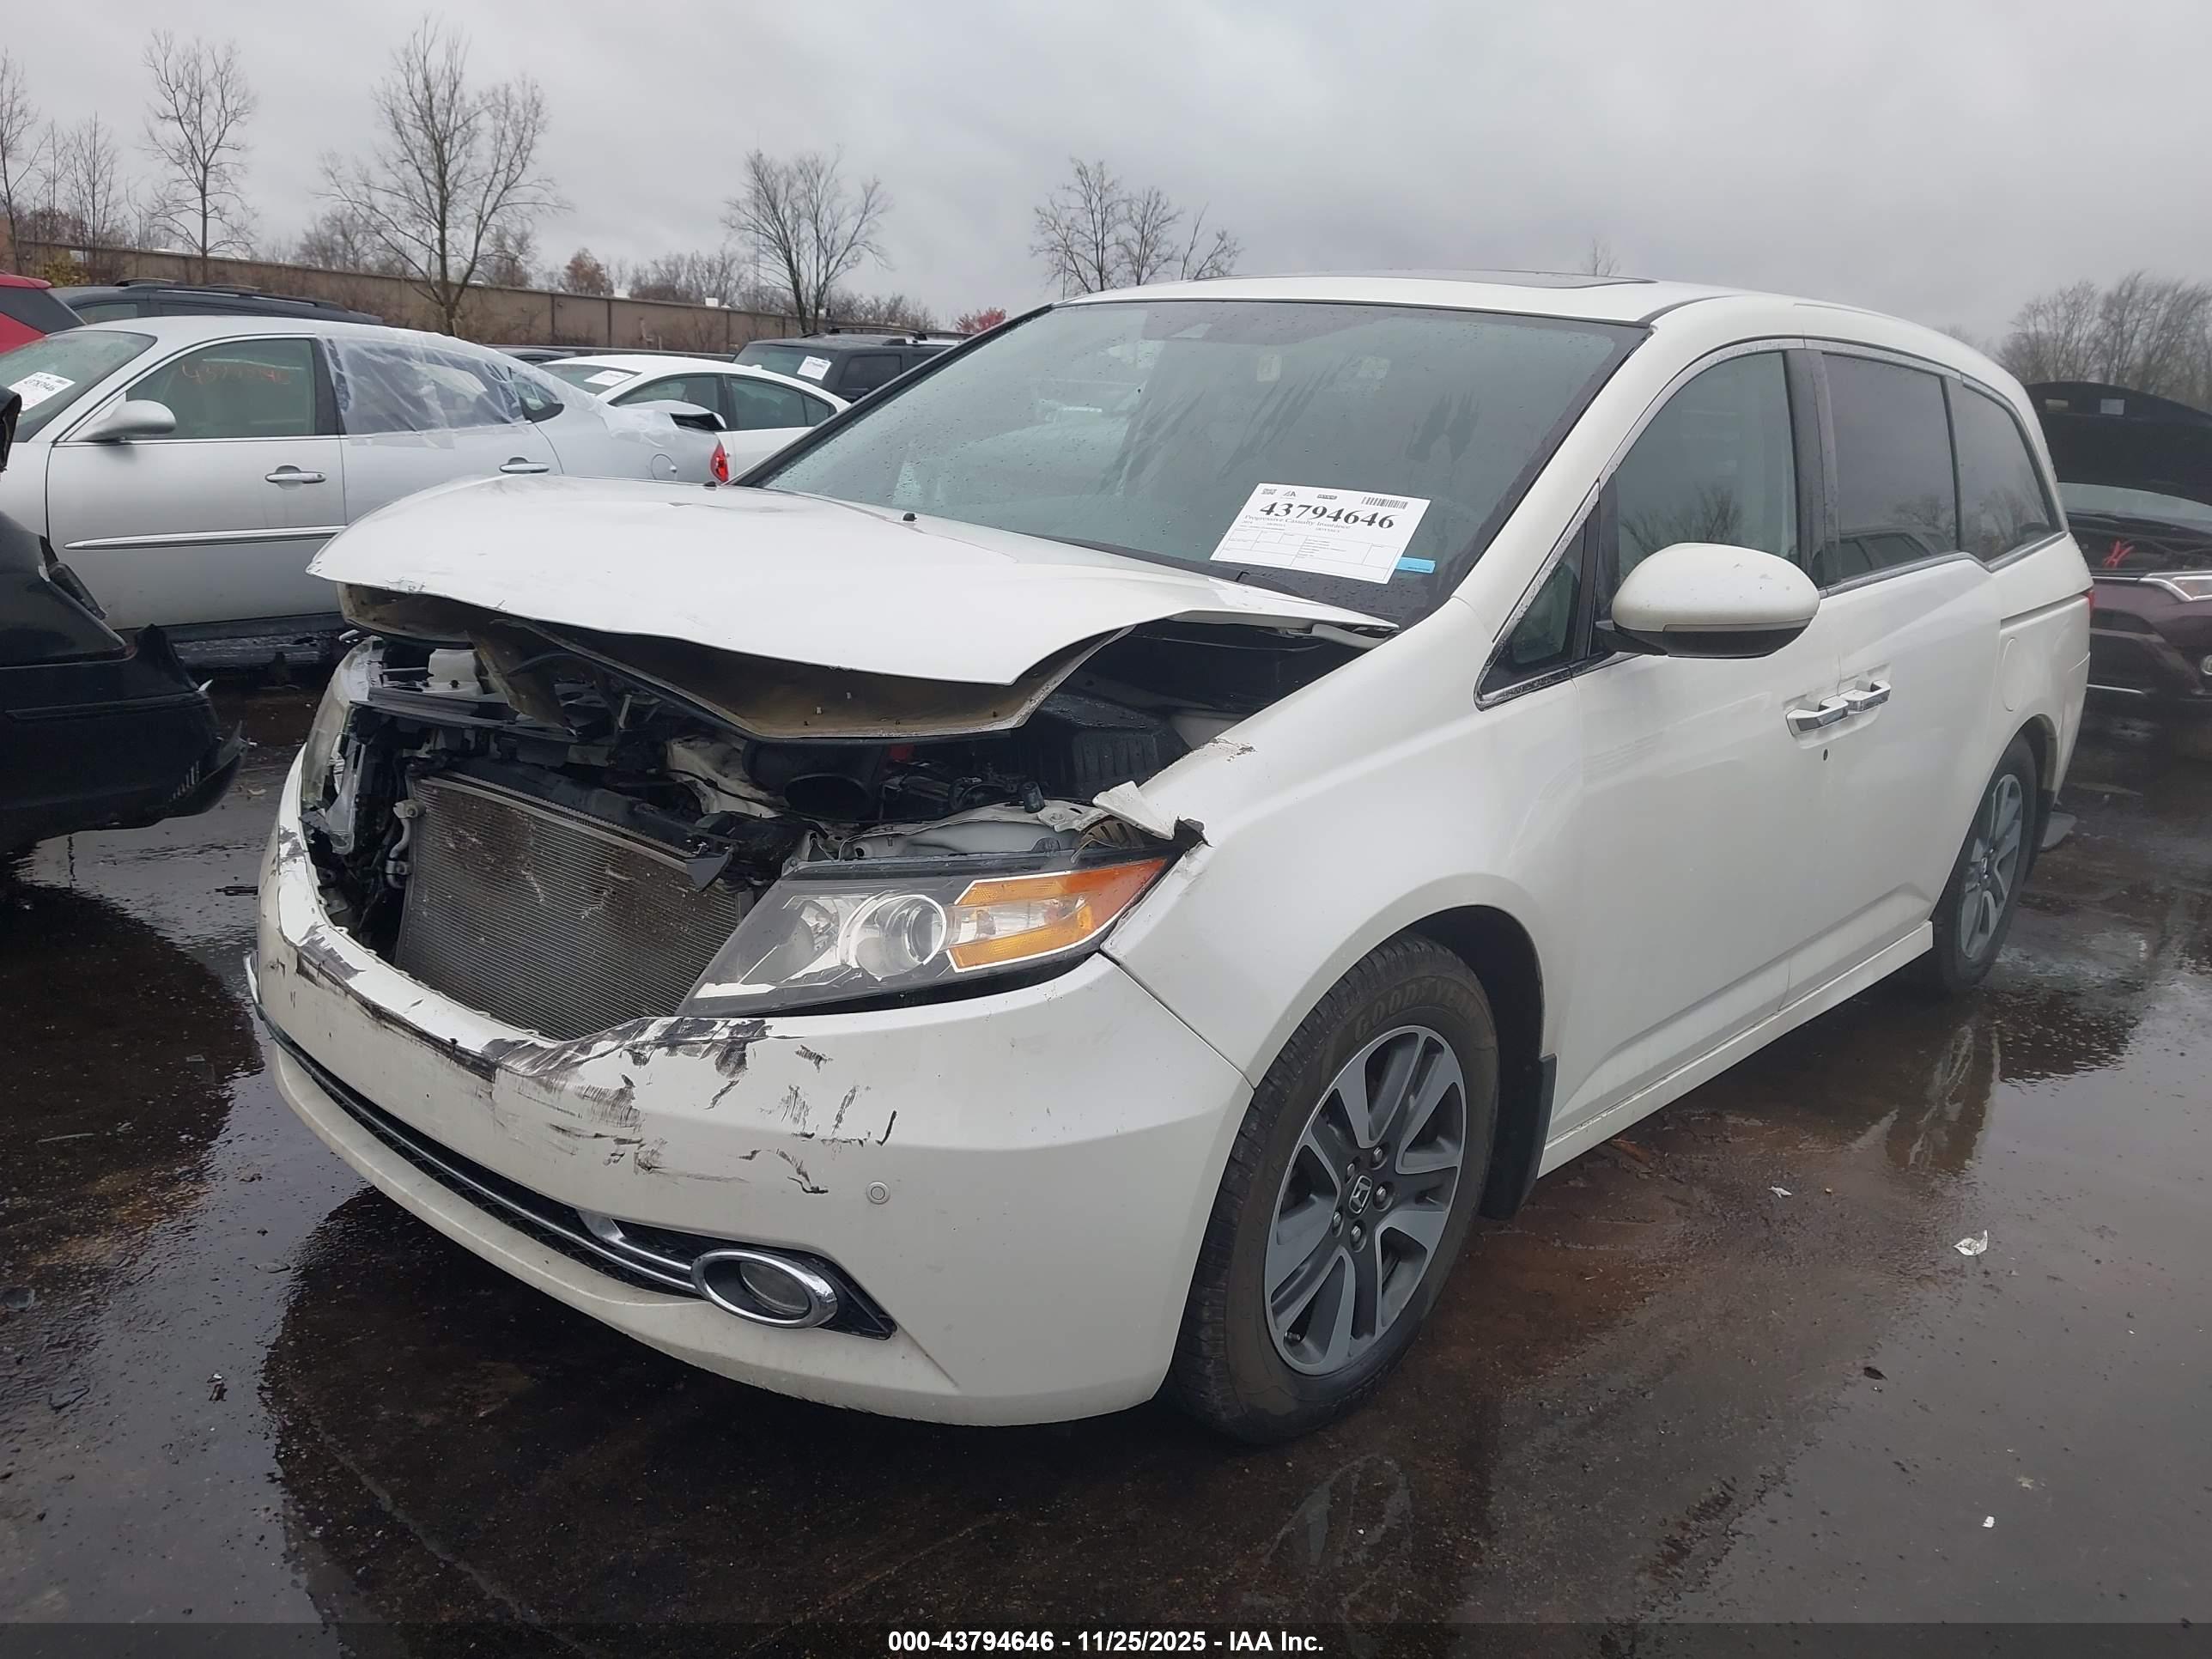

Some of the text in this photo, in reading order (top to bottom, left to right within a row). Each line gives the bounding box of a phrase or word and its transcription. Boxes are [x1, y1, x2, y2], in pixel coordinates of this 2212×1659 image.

[1244, 514, 1284, 523] Progressive
[1285, 517, 1315, 526] Casualty
[1317, 520, 1351, 530] Insurance
[1259, 501, 1397, 529] 43794646
